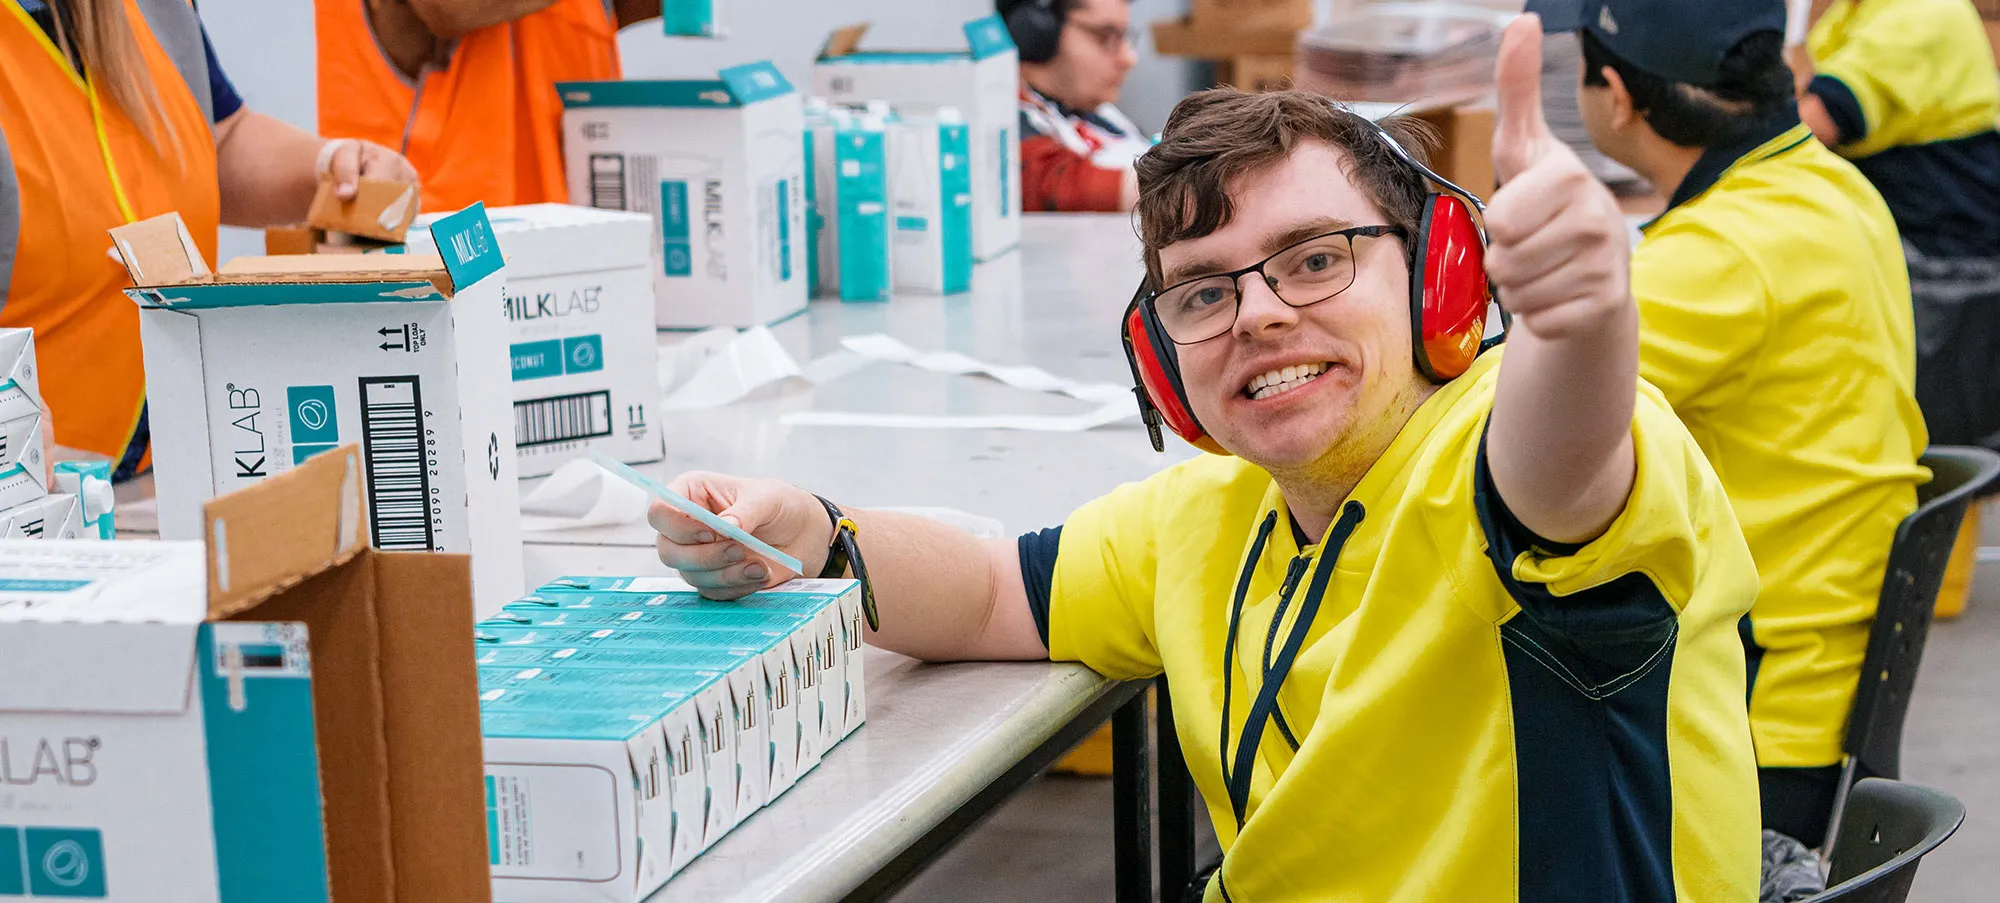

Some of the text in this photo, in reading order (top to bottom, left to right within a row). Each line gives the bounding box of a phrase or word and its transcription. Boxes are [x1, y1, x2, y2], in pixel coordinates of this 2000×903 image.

[450, 220, 489, 266] MILKLAB
[411, 322, 420, 353] TOP LOAD
[419, 328, 427, 346] ONLY
[424, 410, 433, 418] 9
[426, 429, 438, 476] 20289
[431, 488, 443, 534] 15090
[0, 736, 98, 786] LAB
